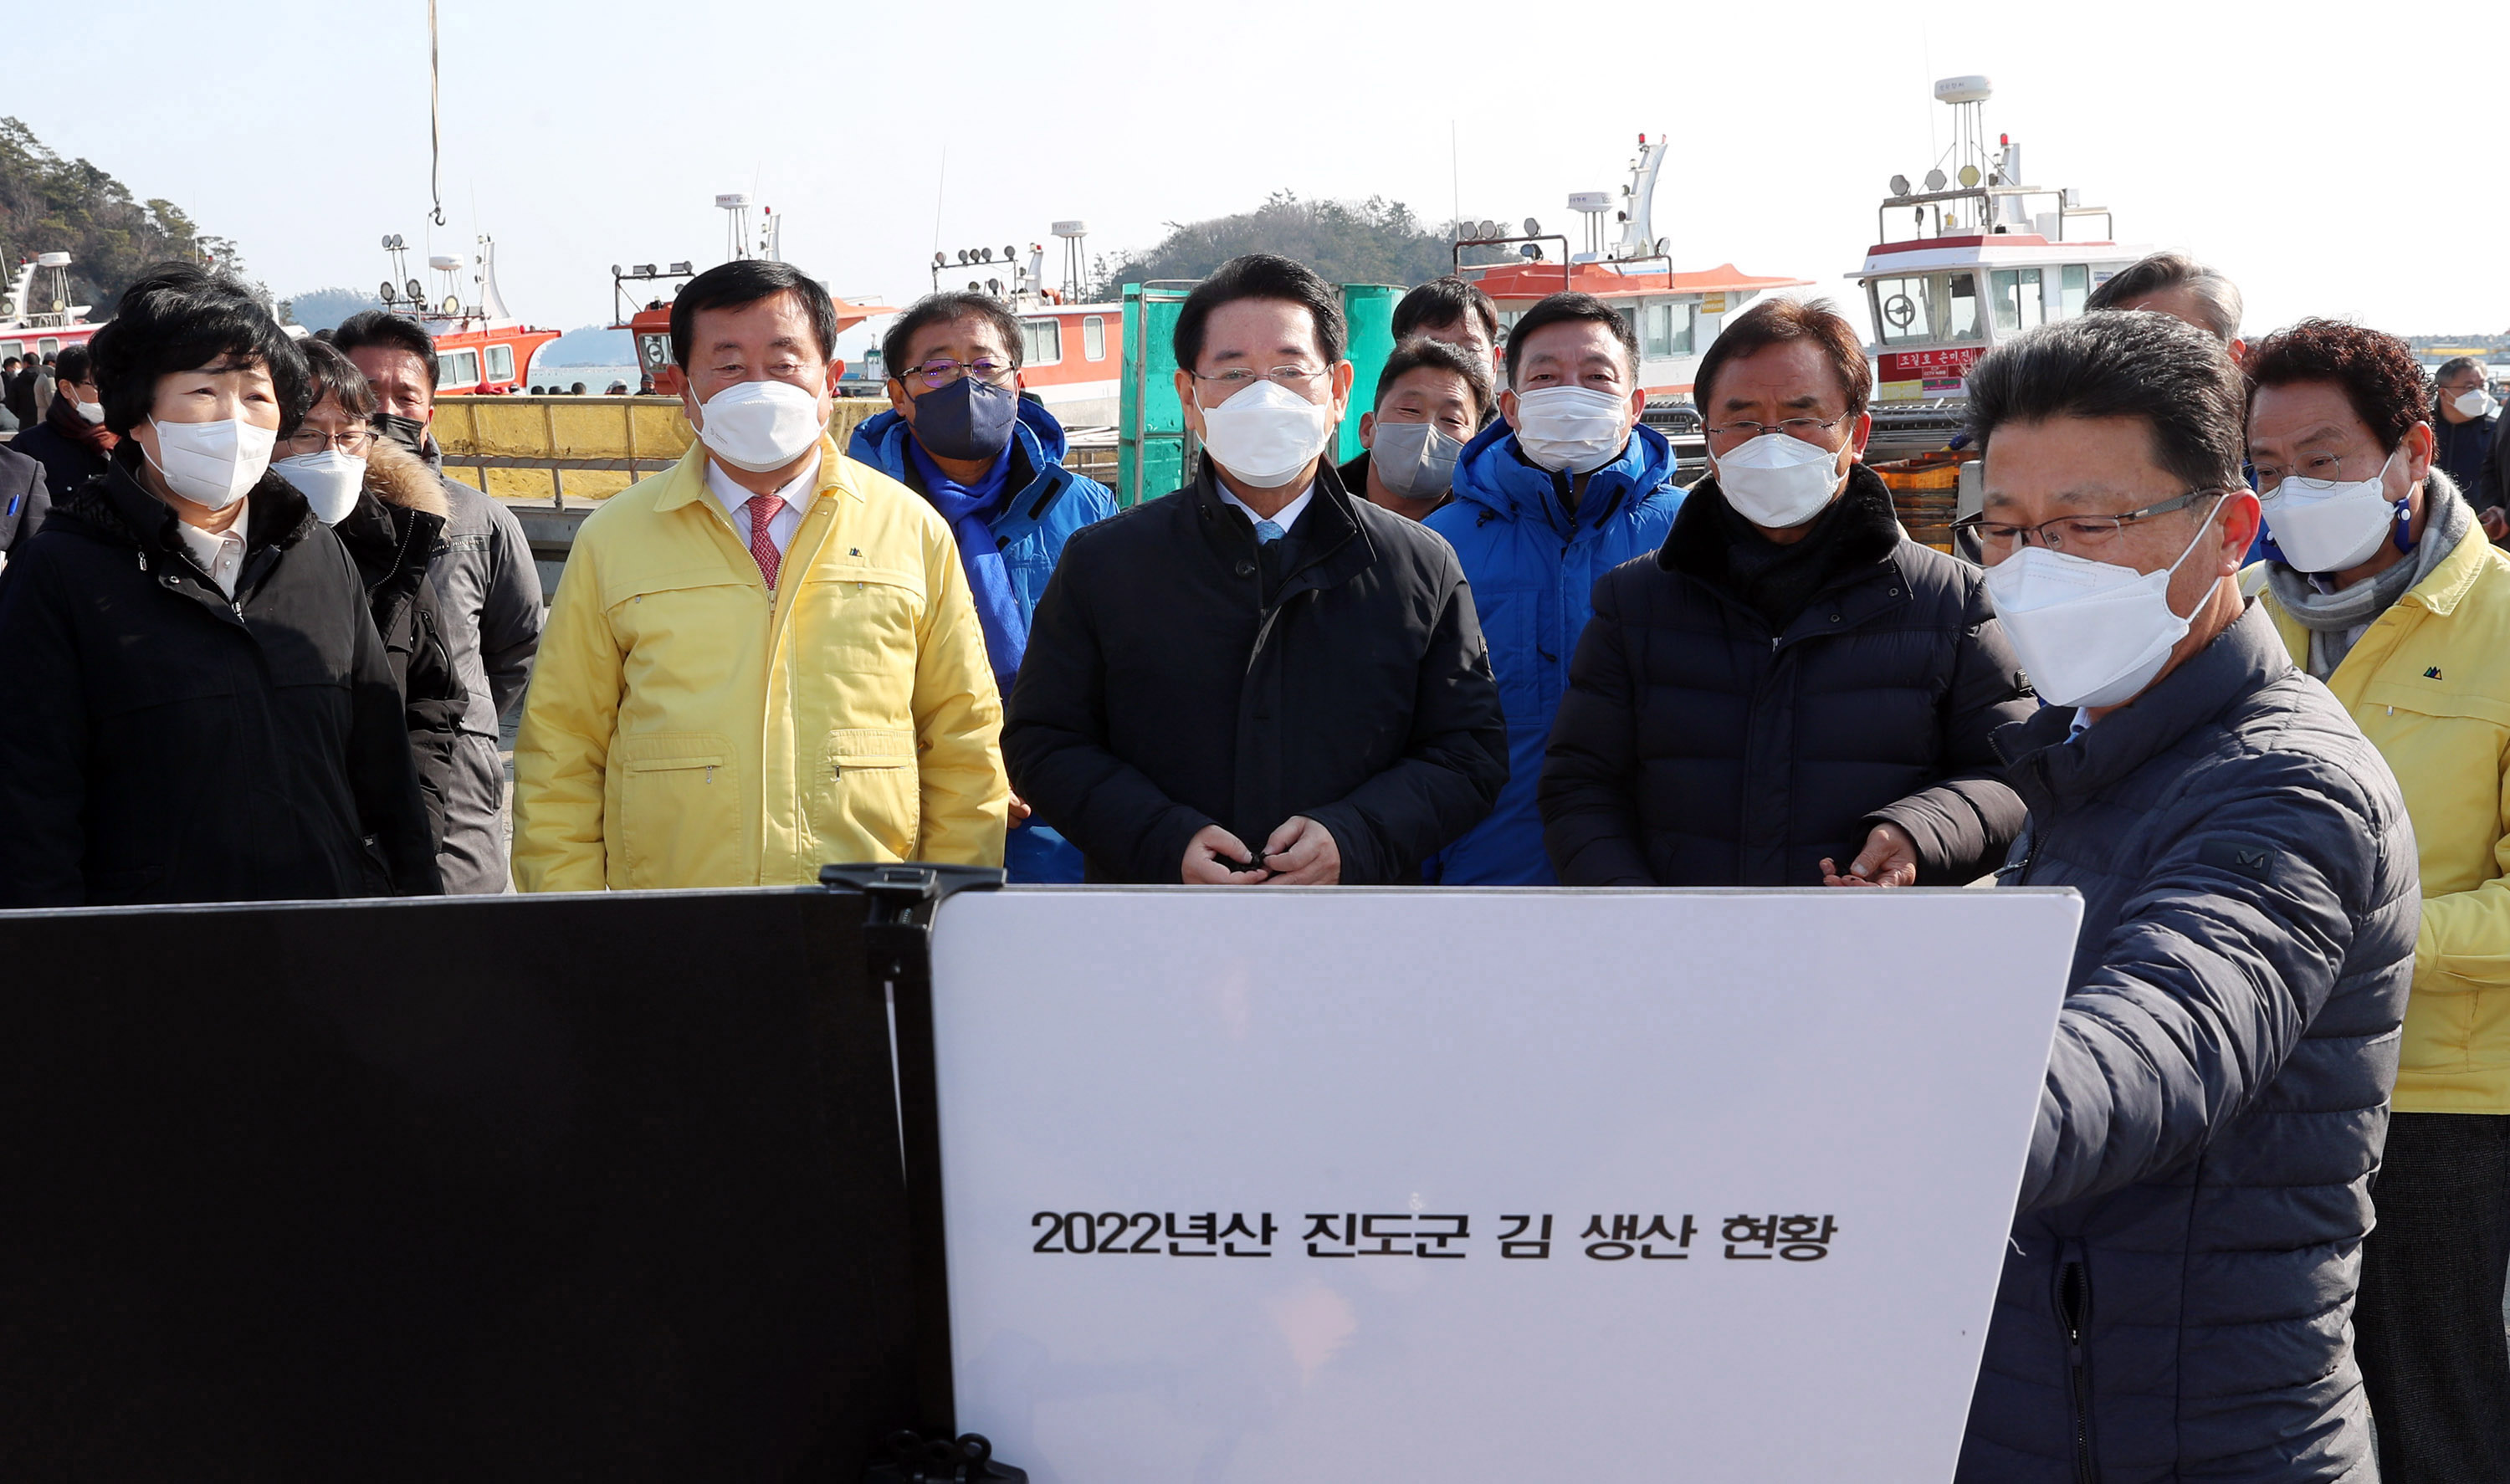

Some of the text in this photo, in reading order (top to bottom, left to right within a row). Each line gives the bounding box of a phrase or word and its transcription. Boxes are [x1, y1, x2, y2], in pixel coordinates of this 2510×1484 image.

[1031, 1210, 1839, 1262] 2022년산 진도군 김 생산 현황
